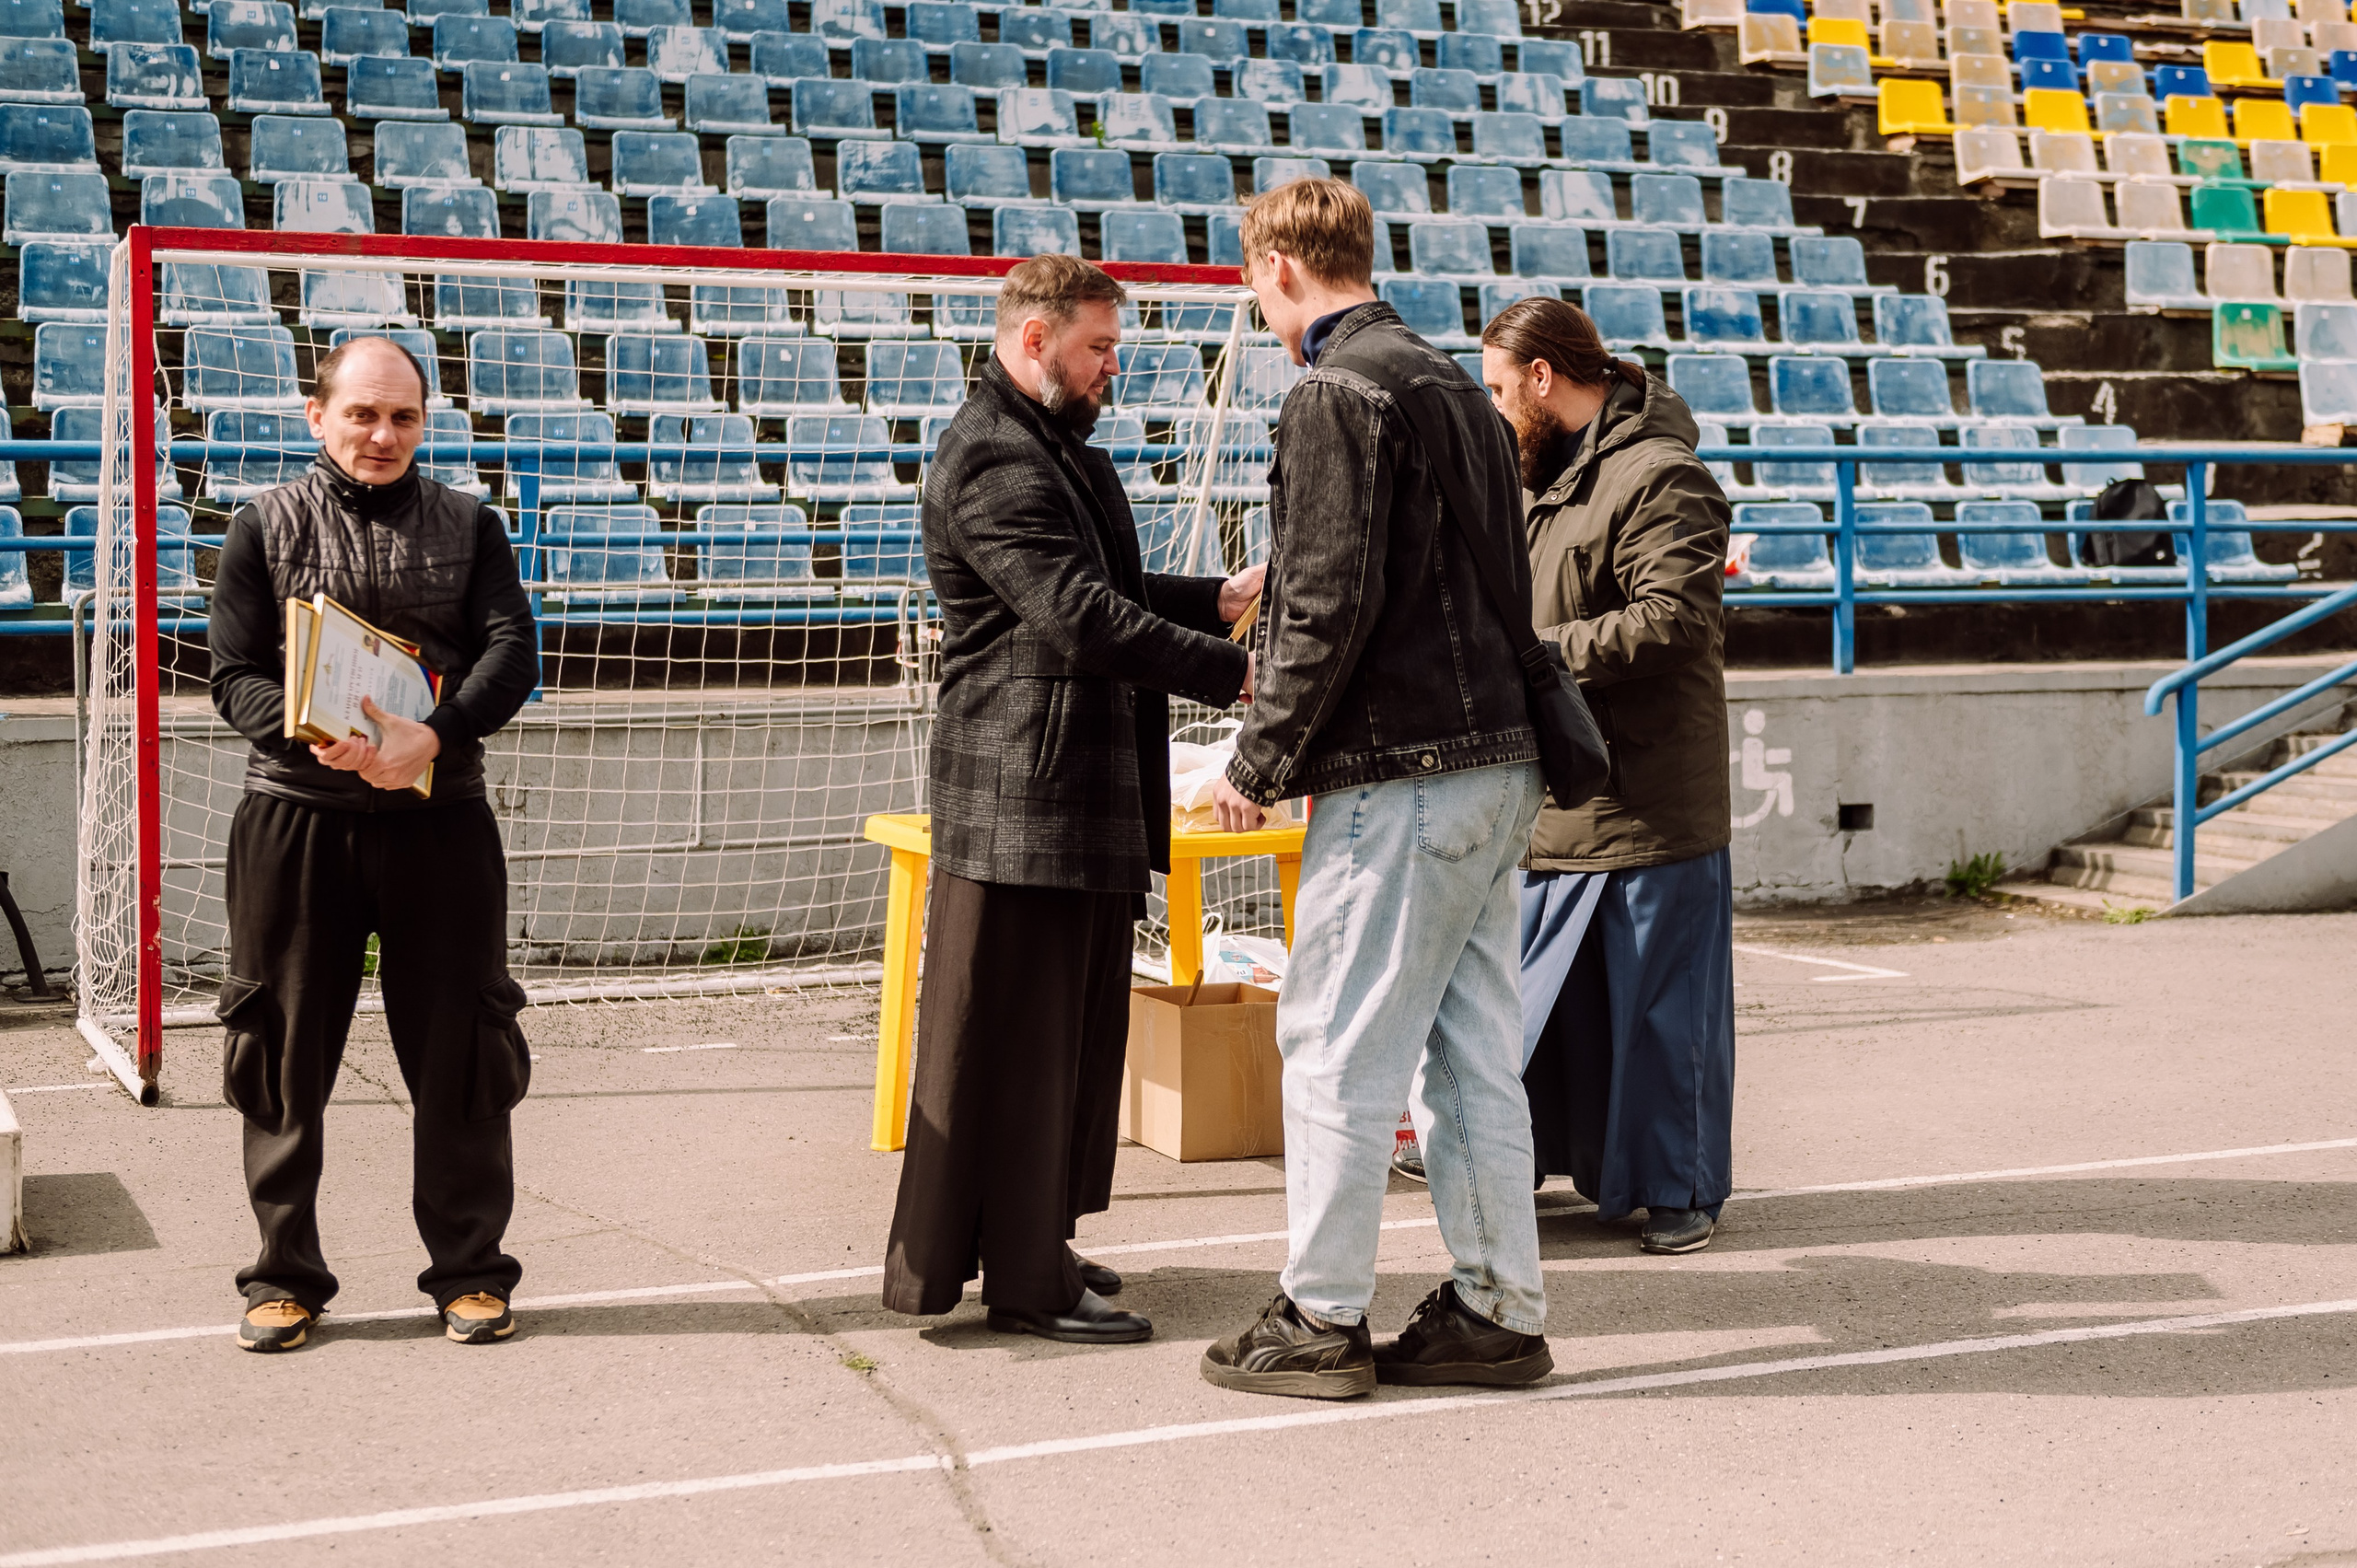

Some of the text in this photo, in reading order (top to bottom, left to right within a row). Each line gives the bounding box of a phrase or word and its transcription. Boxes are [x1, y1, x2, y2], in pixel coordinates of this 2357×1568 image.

[1524, 0, 1562, 27] 12
[1579, 30, 1610, 67] 11
[1639, 73, 1680, 107] 10
[1704, 108, 1728, 145] 9
[1769, 150, 1793, 186] 8
[1844, 196, 1867, 228] 7
[1924, 255, 1950, 297] 6
[2001, 326, 2026, 361] 5
[2090, 380, 2117, 425] 4
